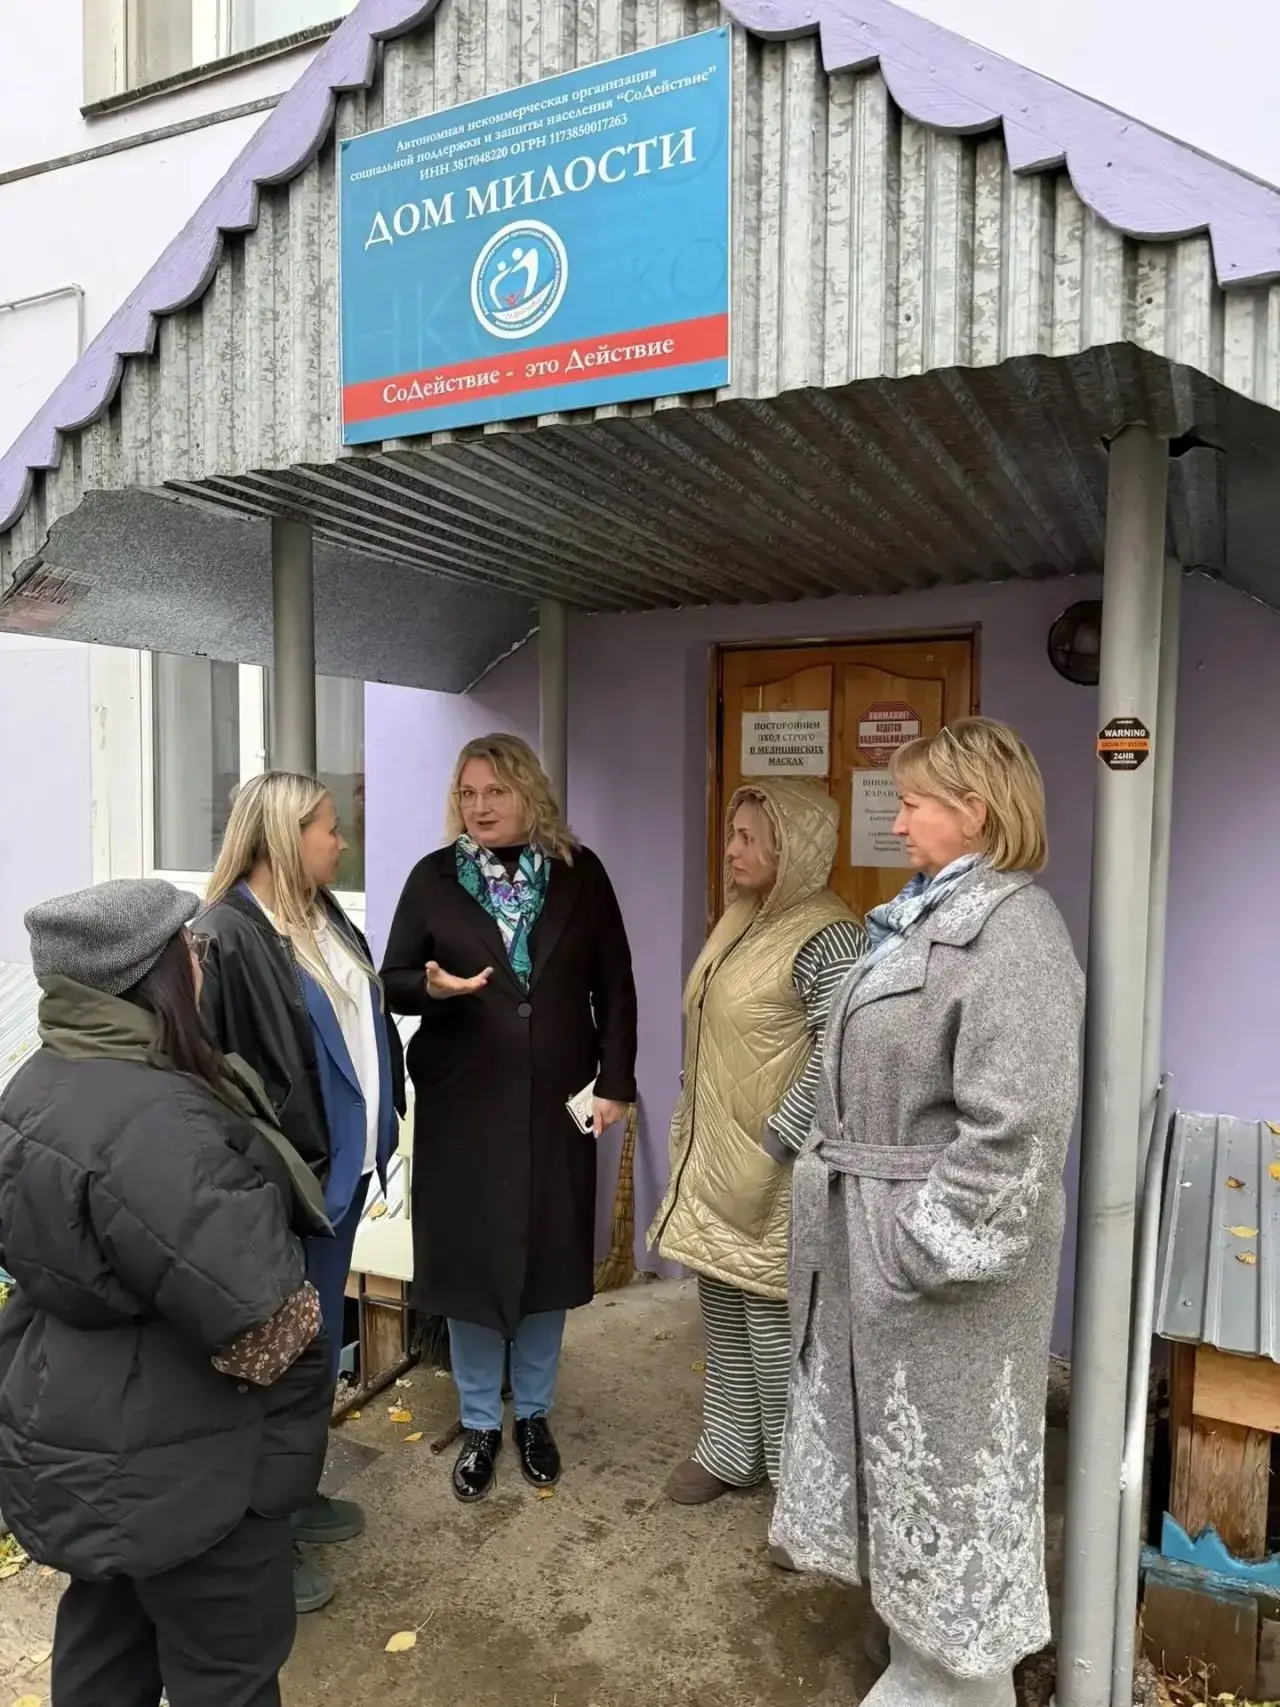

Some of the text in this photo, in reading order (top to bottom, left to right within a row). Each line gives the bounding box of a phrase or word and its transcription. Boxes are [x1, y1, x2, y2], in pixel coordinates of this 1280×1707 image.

[395, 68, 657, 152] Автономная некоммерческая организация
[350, 154, 414, 182] социальной
[416, 138, 481, 163] поддержки
[484, 134, 492, 144] и
[494, 118, 544, 140] защиты
[546, 100, 613, 126] населения
[420, 113, 628, 181] ИНН 3817048220 ОГРН 1173850017263
[364, 128, 698, 250] ДОМ МИЛОСТИ
[382, 367, 500, 405] СоДействие
[525, 358, 560, 379] это
[564, 338, 675, 373] Действие
[754, 721, 820, 730] ПОСТОРОННИМ
[876, 723, 902, 733] ВЕДЕТСЯ
[758, 733, 816, 742] ВХОД СТРОГО
[1104, 729, 1146, 737] WARNING
[750, 746, 824, 755] В МЕДИЦИНСКИХ
[768, 757, 804, 766] МАСКАХ
